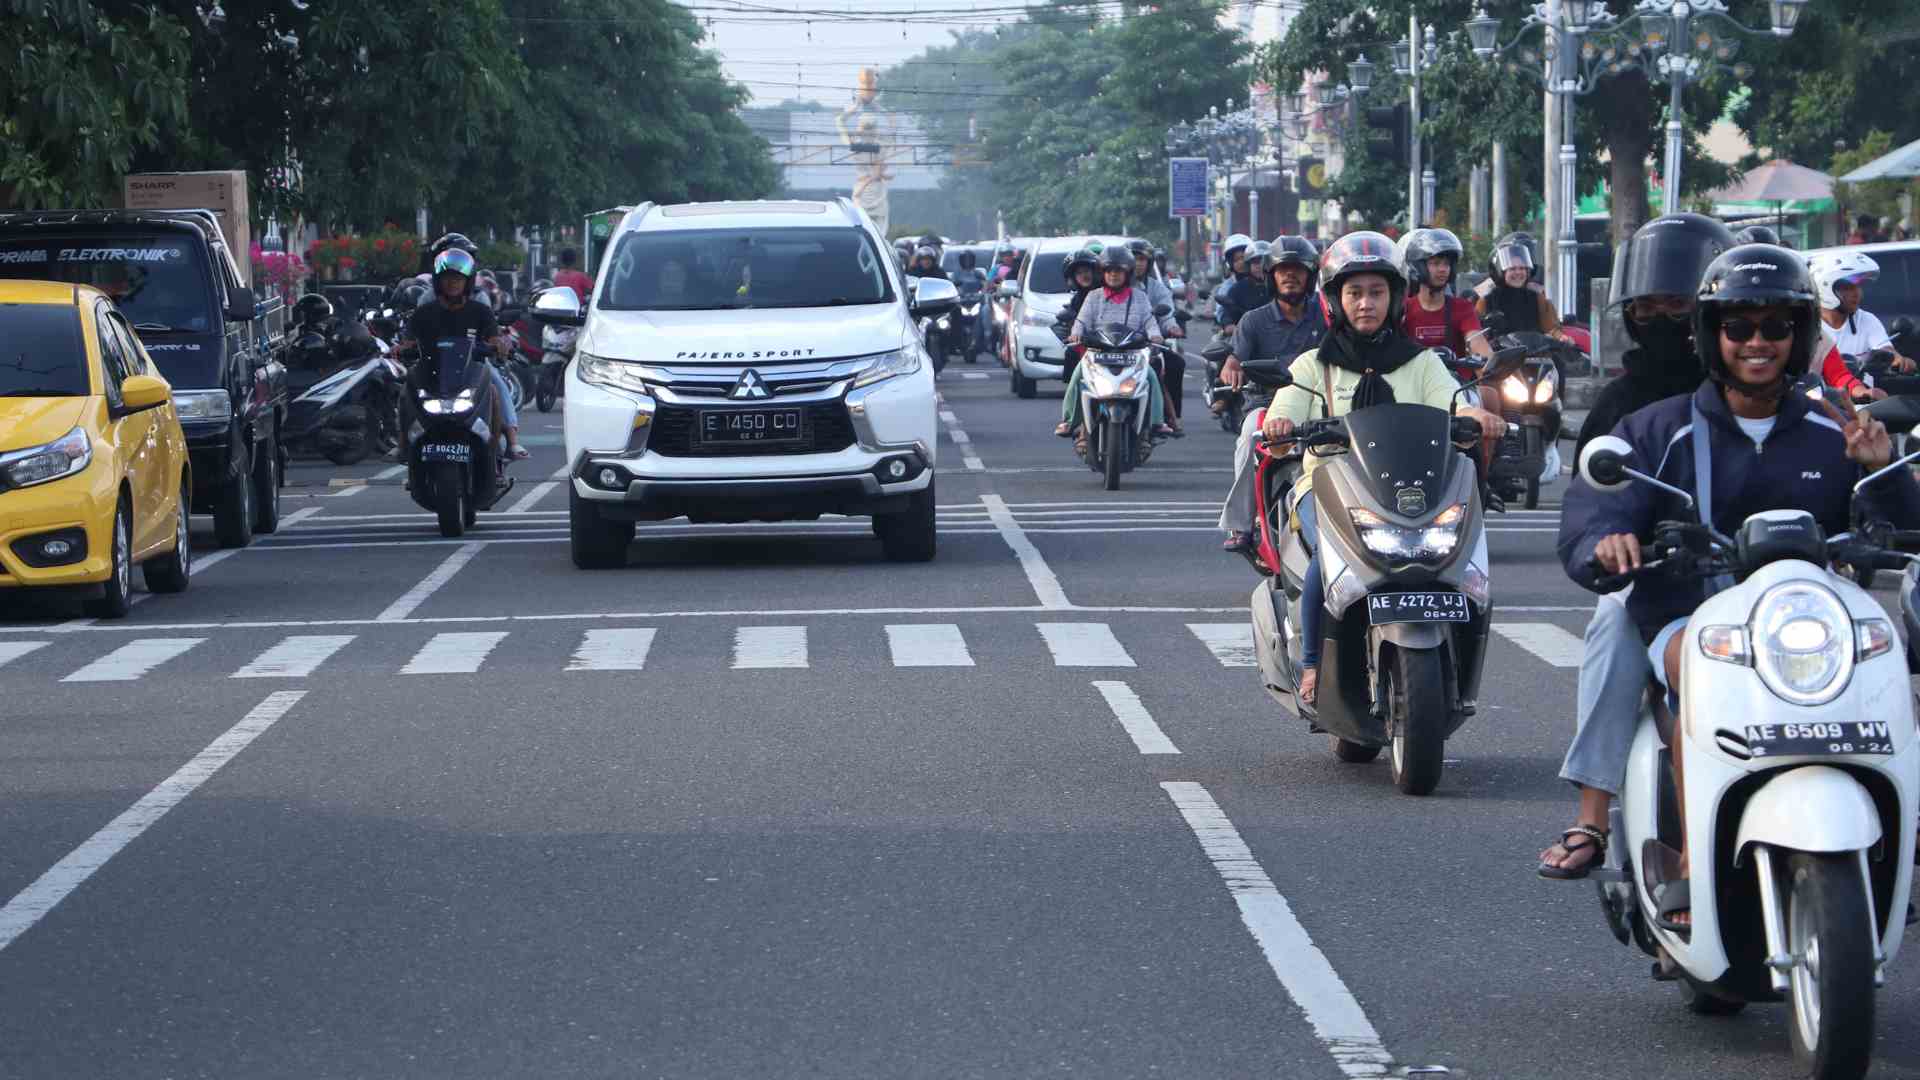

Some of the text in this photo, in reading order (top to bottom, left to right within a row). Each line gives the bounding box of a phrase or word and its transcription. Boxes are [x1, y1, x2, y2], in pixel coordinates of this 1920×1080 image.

[130, 182, 176, 190] SHARP
[676, 348, 815, 359] PAJERO SPORT
[706, 415, 717, 430] E
[725, 414, 765, 430] 1450
[1801, 471, 1822, 479] FILA
[1372, 596, 1391, 609] AE
[1399, 595, 1435, 608] 4272
[1423, 610, 1464, 618] 06-27
[1748, 721, 1888, 741] AE 6509 WV
